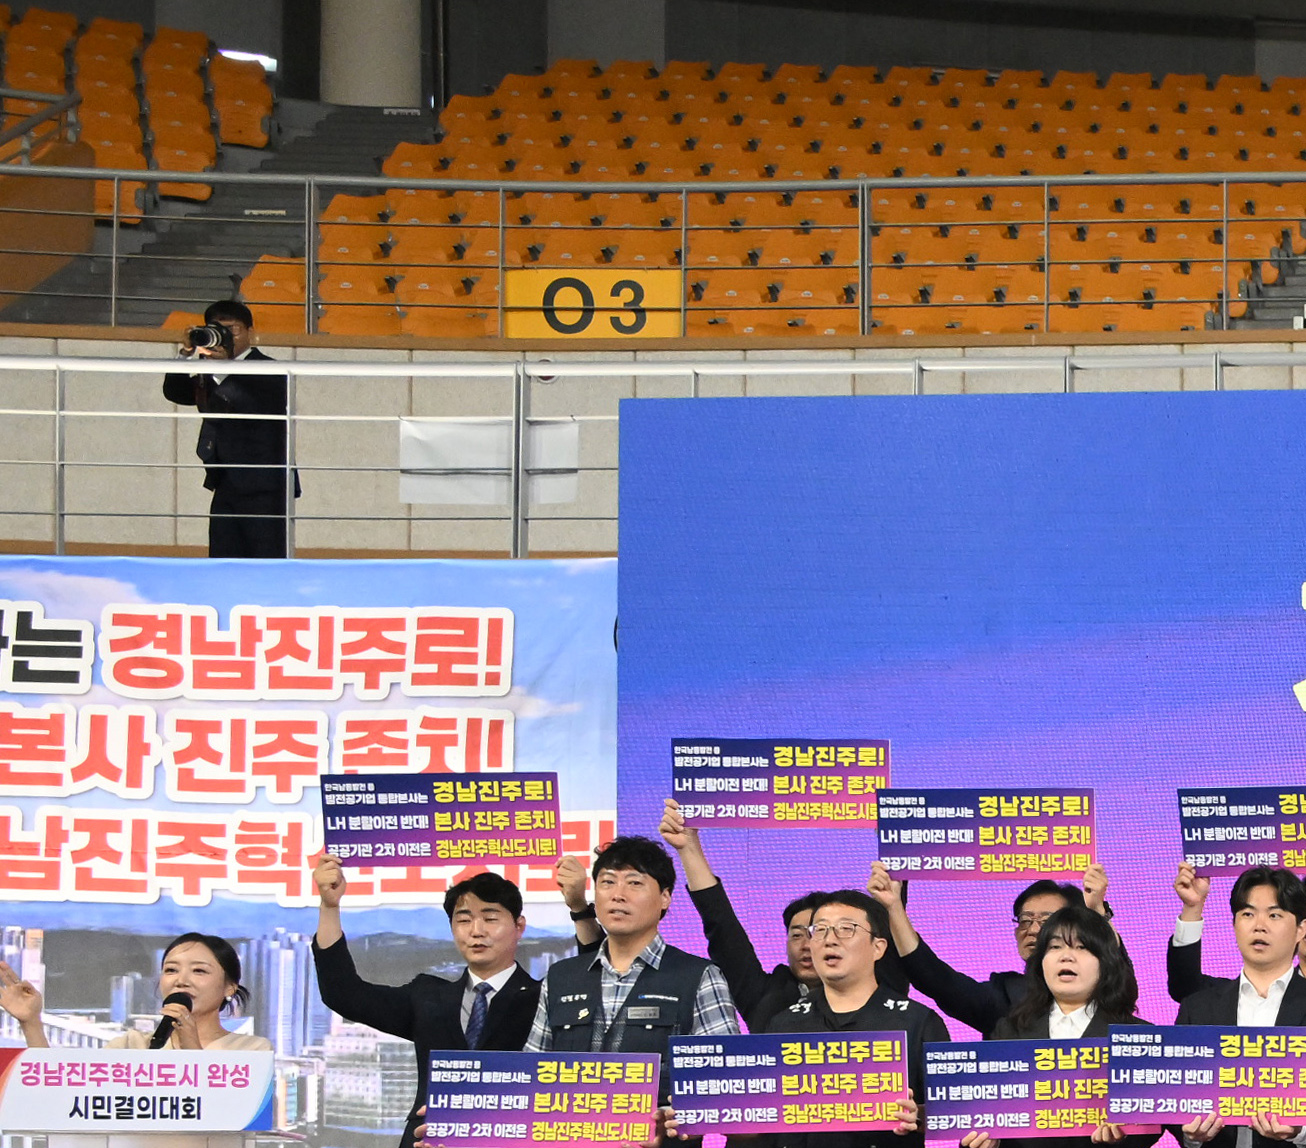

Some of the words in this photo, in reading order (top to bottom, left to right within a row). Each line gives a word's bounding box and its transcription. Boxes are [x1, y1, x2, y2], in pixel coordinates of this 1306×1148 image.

[0, 609, 83, 684] 는
[110, 612, 504, 691] 경남진주로!
[0, 711, 151, 789] 본사
[173, 718, 319, 793] 진주
[773, 745, 885, 767] 경남진주로!
[432, 779, 553, 803] 경남진주로!
[978, 794, 1089, 818] 경남진주로!
[433, 810, 471, 832] 본사
[473, 810, 511, 831] 진주
[513, 809, 556, 831] 존치!
[978, 824, 1013, 846] 본사
[1014, 824, 1049, 846] 진주
[1052, 824, 1091, 846] 존치!
[780, 1039, 901, 1065] 경남진주로!
[20, 1061, 199, 1088] 경남진주혁신도시
[207, 1063, 250, 1088] 완성
[430, 1069, 481, 1083] 발전공기업
[480, 1070, 532, 1084] 통합본사는
[536, 1060, 653, 1084] 경남진주로!
[781, 1072, 819, 1096] 본사
[820, 1072, 858, 1095] 진주
[861, 1071, 903, 1094] 존치!
[1217, 1065, 1256, 1088] 본사
[1257, 1066, 1294, 1089] 진주
[69, 1095, 201, 1121] 시민결의대회
[428, 1093, 449, 1109] LH
[449, 1093, 499, 1110] 분할이전
[499, 1093, 529, 1110] 반대!
[533, 1091, 570, 1113] 본사
[572, 1091, 608, 1114] 진주
[611, 1092, 653, 1114] 존치!
[424, 1120, 471, 1138] 공공기관
[470, 1121, 493, 1138] 2차
[492, 1122, 528, 1139] 이전은
[531, 1120, 650, 1142] 경남진주혁신도시로!
